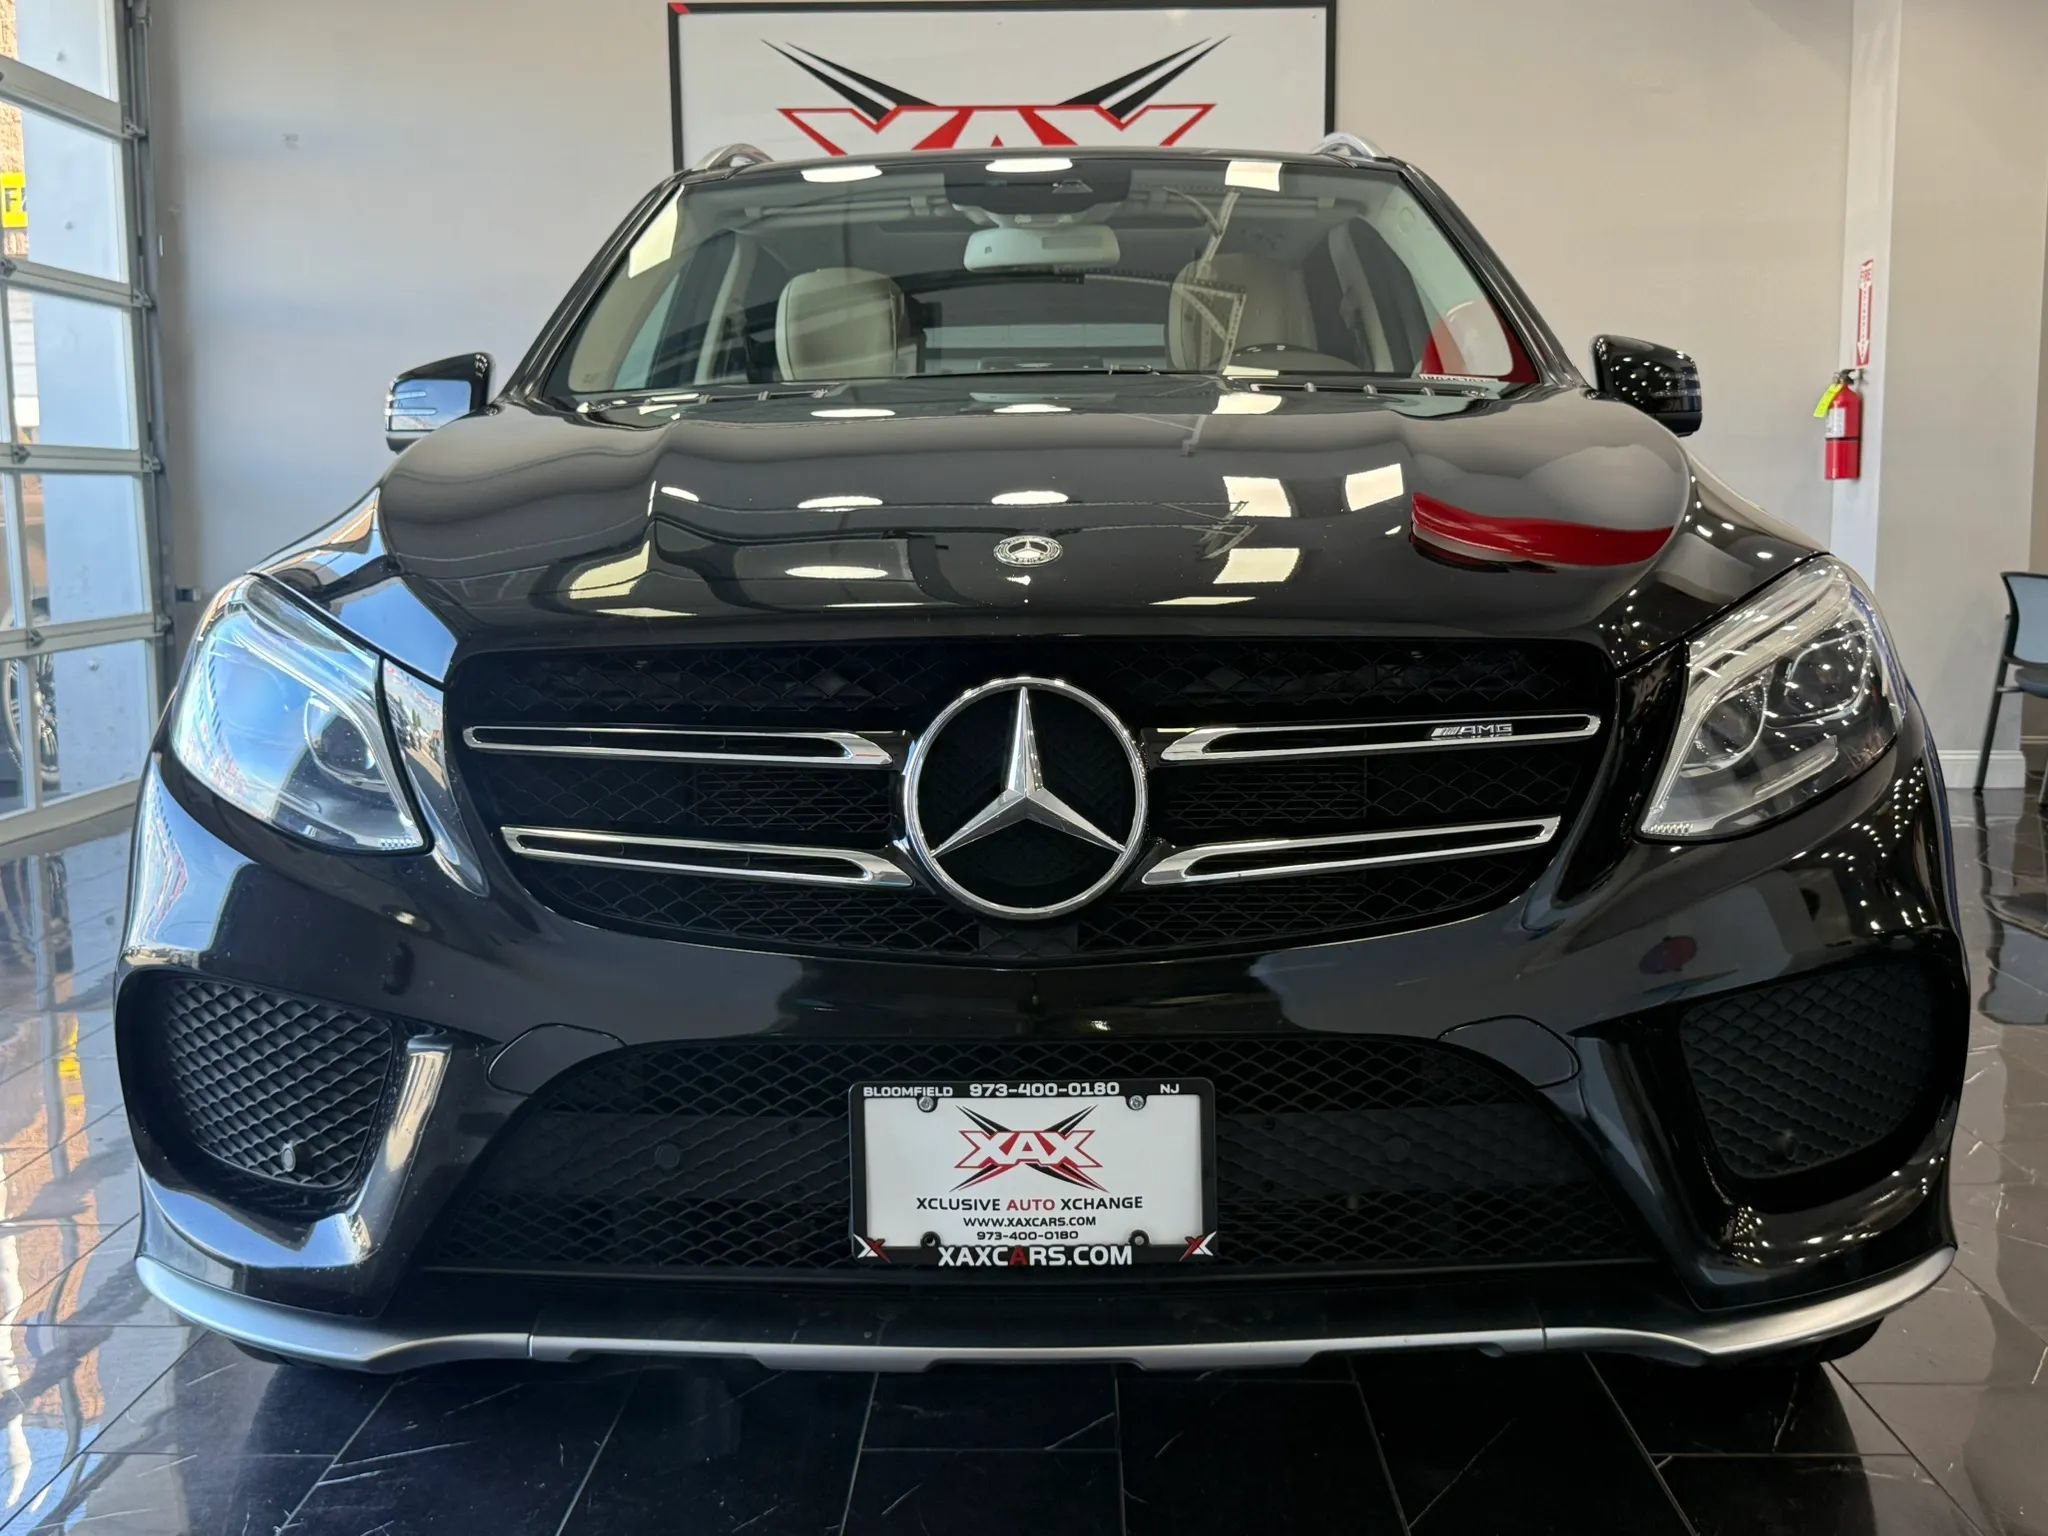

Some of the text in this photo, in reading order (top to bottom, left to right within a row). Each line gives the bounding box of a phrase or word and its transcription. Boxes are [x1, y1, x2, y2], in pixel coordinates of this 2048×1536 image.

[863, 1081, 1180, 1097] BLOOMFIELD 973-400-0180 NJ
[954, 1130, 1103, 1168] XAX
[916, 1196, 1144, 1211] XCLUSIVE AUTO XCHANGE
[963, 1216, 1096, 1227] WWW.XAXCARS.COM
[976, 1230, 1079, 1241] 973-400-0180
[938, 1245, 1133, 1267] XAXCARS.COM
